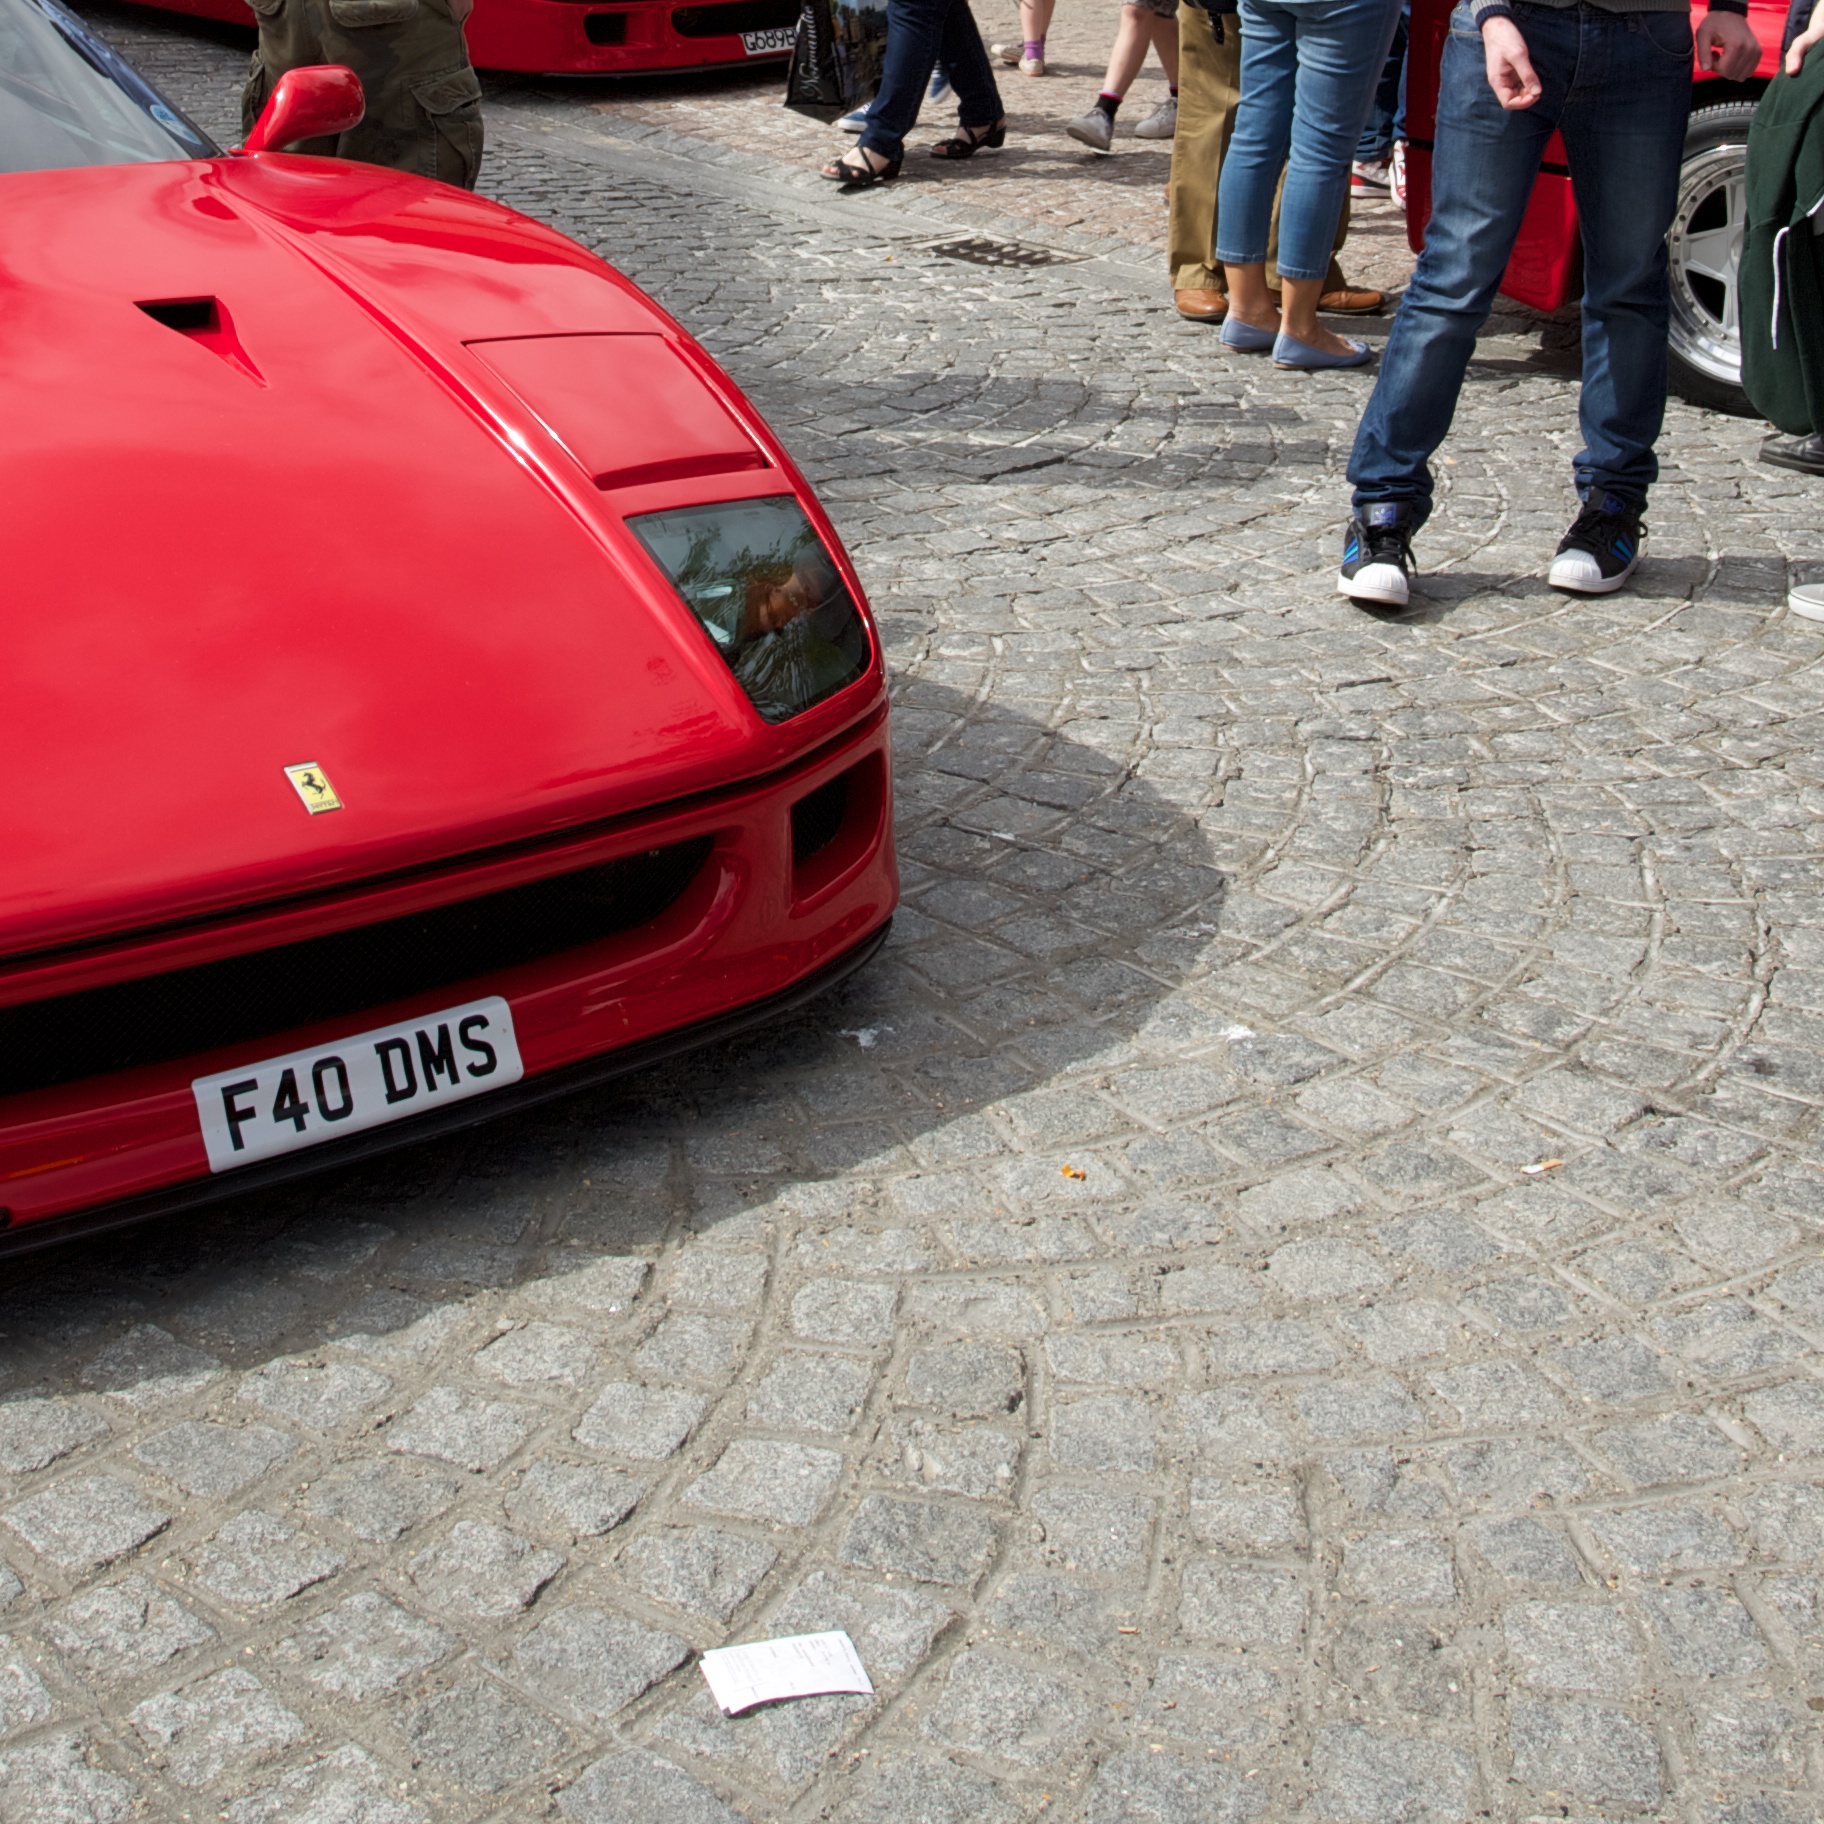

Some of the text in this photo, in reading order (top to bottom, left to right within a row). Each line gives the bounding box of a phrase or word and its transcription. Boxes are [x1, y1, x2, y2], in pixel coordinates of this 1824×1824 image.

[799, 6, 824, 101] Normandie
[221, 1014, 497, 1152] F40 DMS
